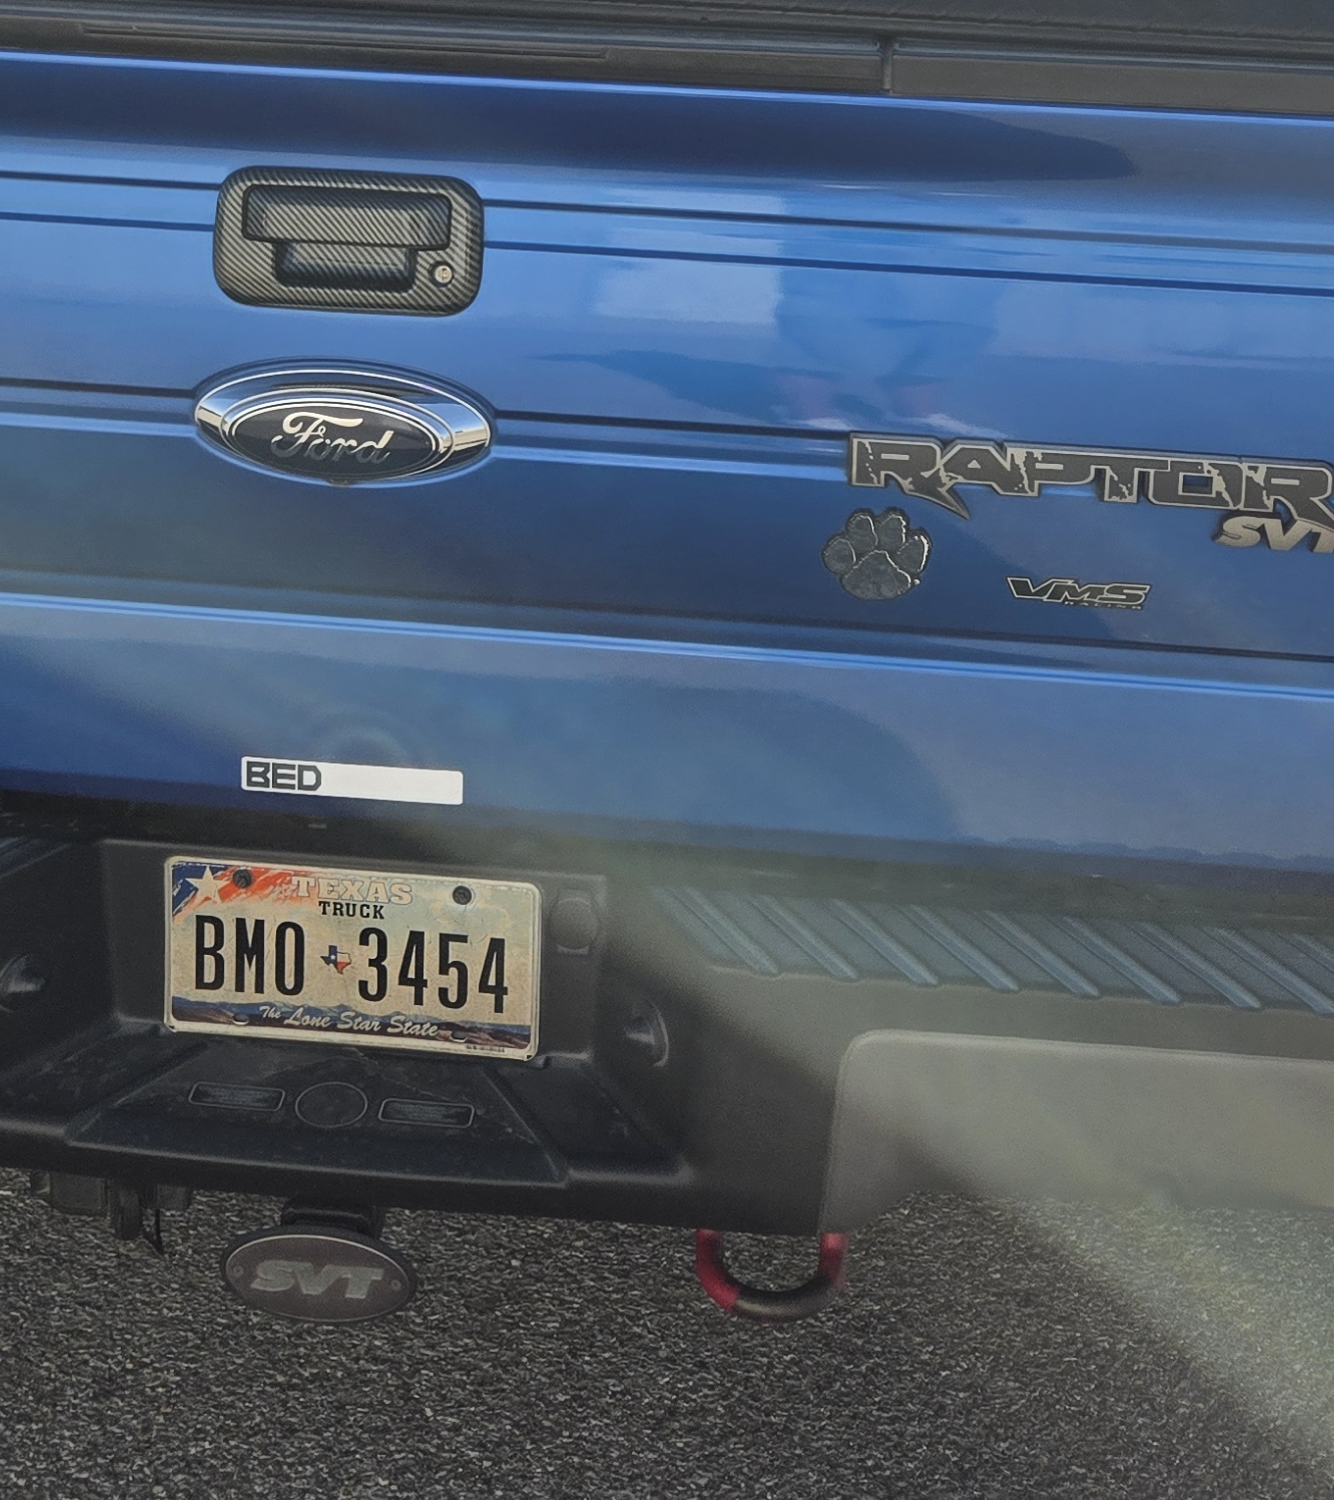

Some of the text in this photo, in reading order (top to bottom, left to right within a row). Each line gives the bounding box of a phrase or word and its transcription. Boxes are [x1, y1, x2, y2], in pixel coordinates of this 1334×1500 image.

[271, 412, 394, 465] Ford
[1006, 577, 1152, 605] VMS
[245, 760, 322, 792] BED
[291, 875, 413, 905] TEXAS
[318, 901, 385, 920] TRUCK
[358, 927, 509, 1013] 3454
[259, 1005, 439, 1037] The Lone Star State
[250, 1259, 384, 1300] SVT
